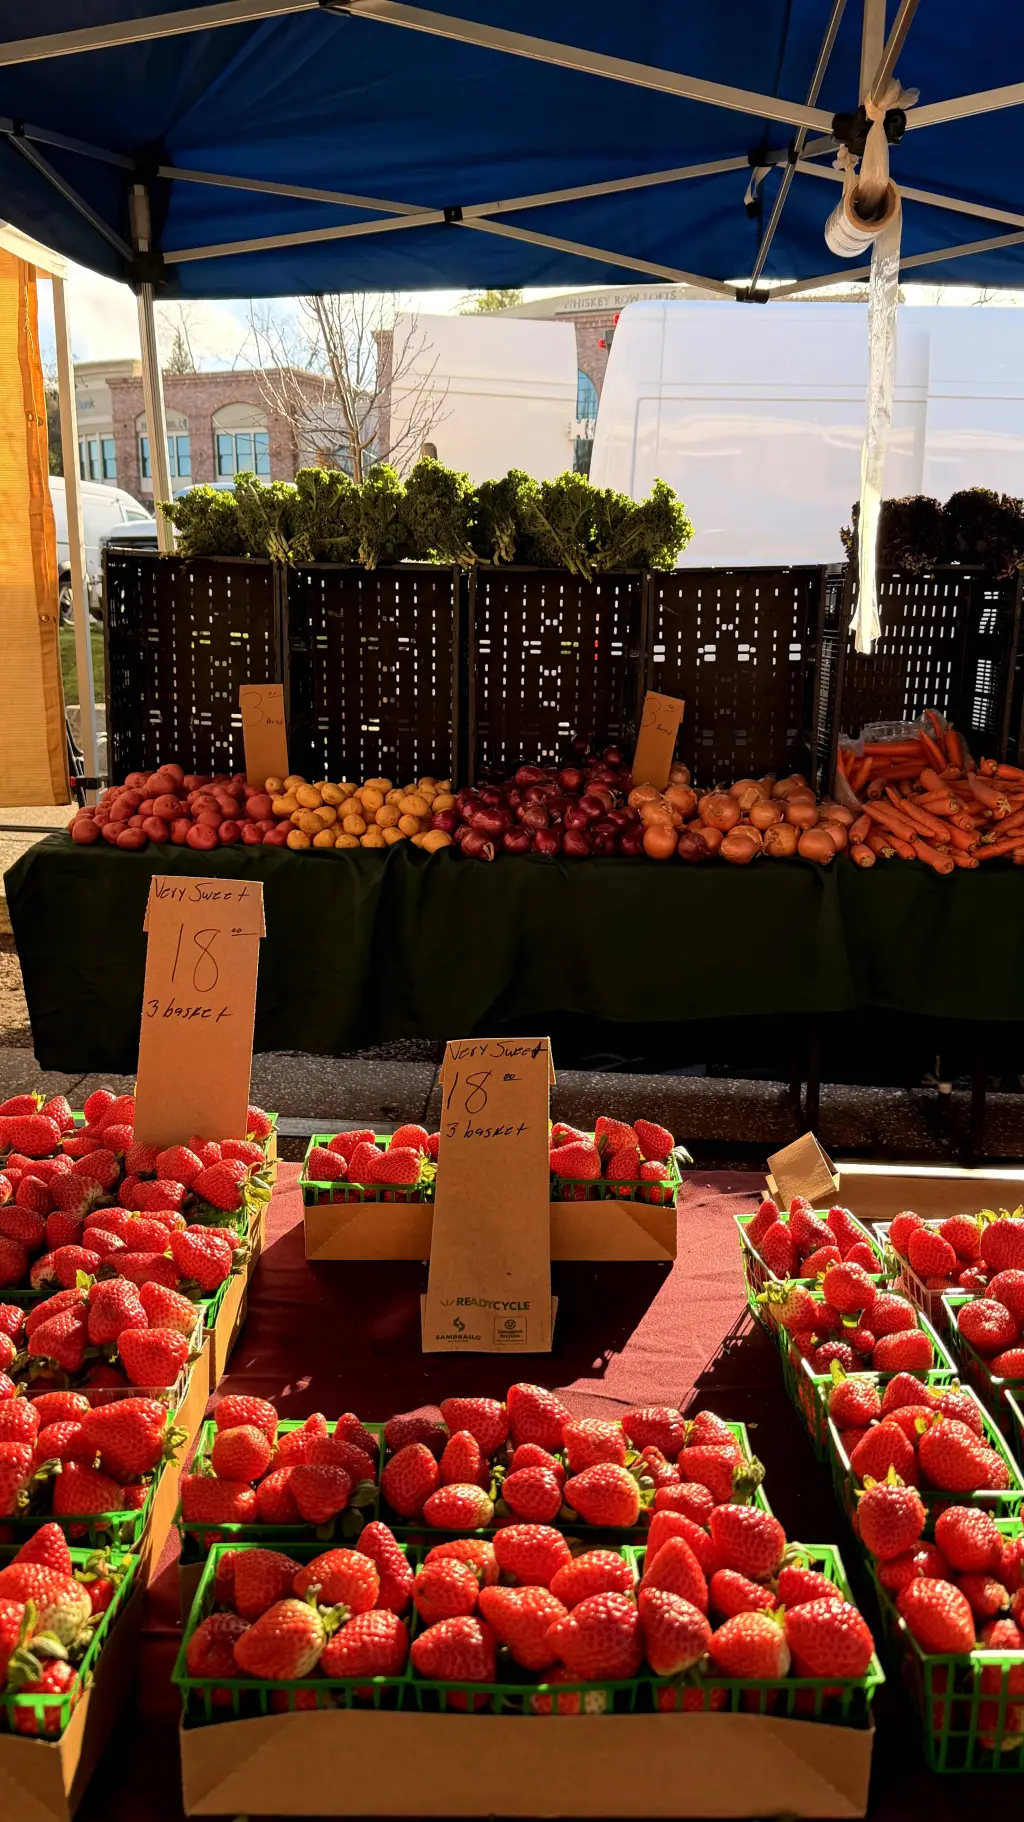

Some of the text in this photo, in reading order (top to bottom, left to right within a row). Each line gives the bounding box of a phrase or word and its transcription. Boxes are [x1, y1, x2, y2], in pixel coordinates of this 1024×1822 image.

[564, 297, 611, 308] WHISKEY
[614, 293, 639, 304] ROW
[243, 692, 263, 726] 3
[642, 698, 661, 727] 3
[154, 877, 250, 902] Very Sweet
[172, 924, 220, 992] 18
[146, 997, 233, 1022] 3 basket
[449, 1041, 548, 1060] Very Sweet
[446, 1070, 492, 1114] 18
[446, 1120, 529, 1138] 3 basket
[457, 1297, 530, 1310] READYCYCLE
